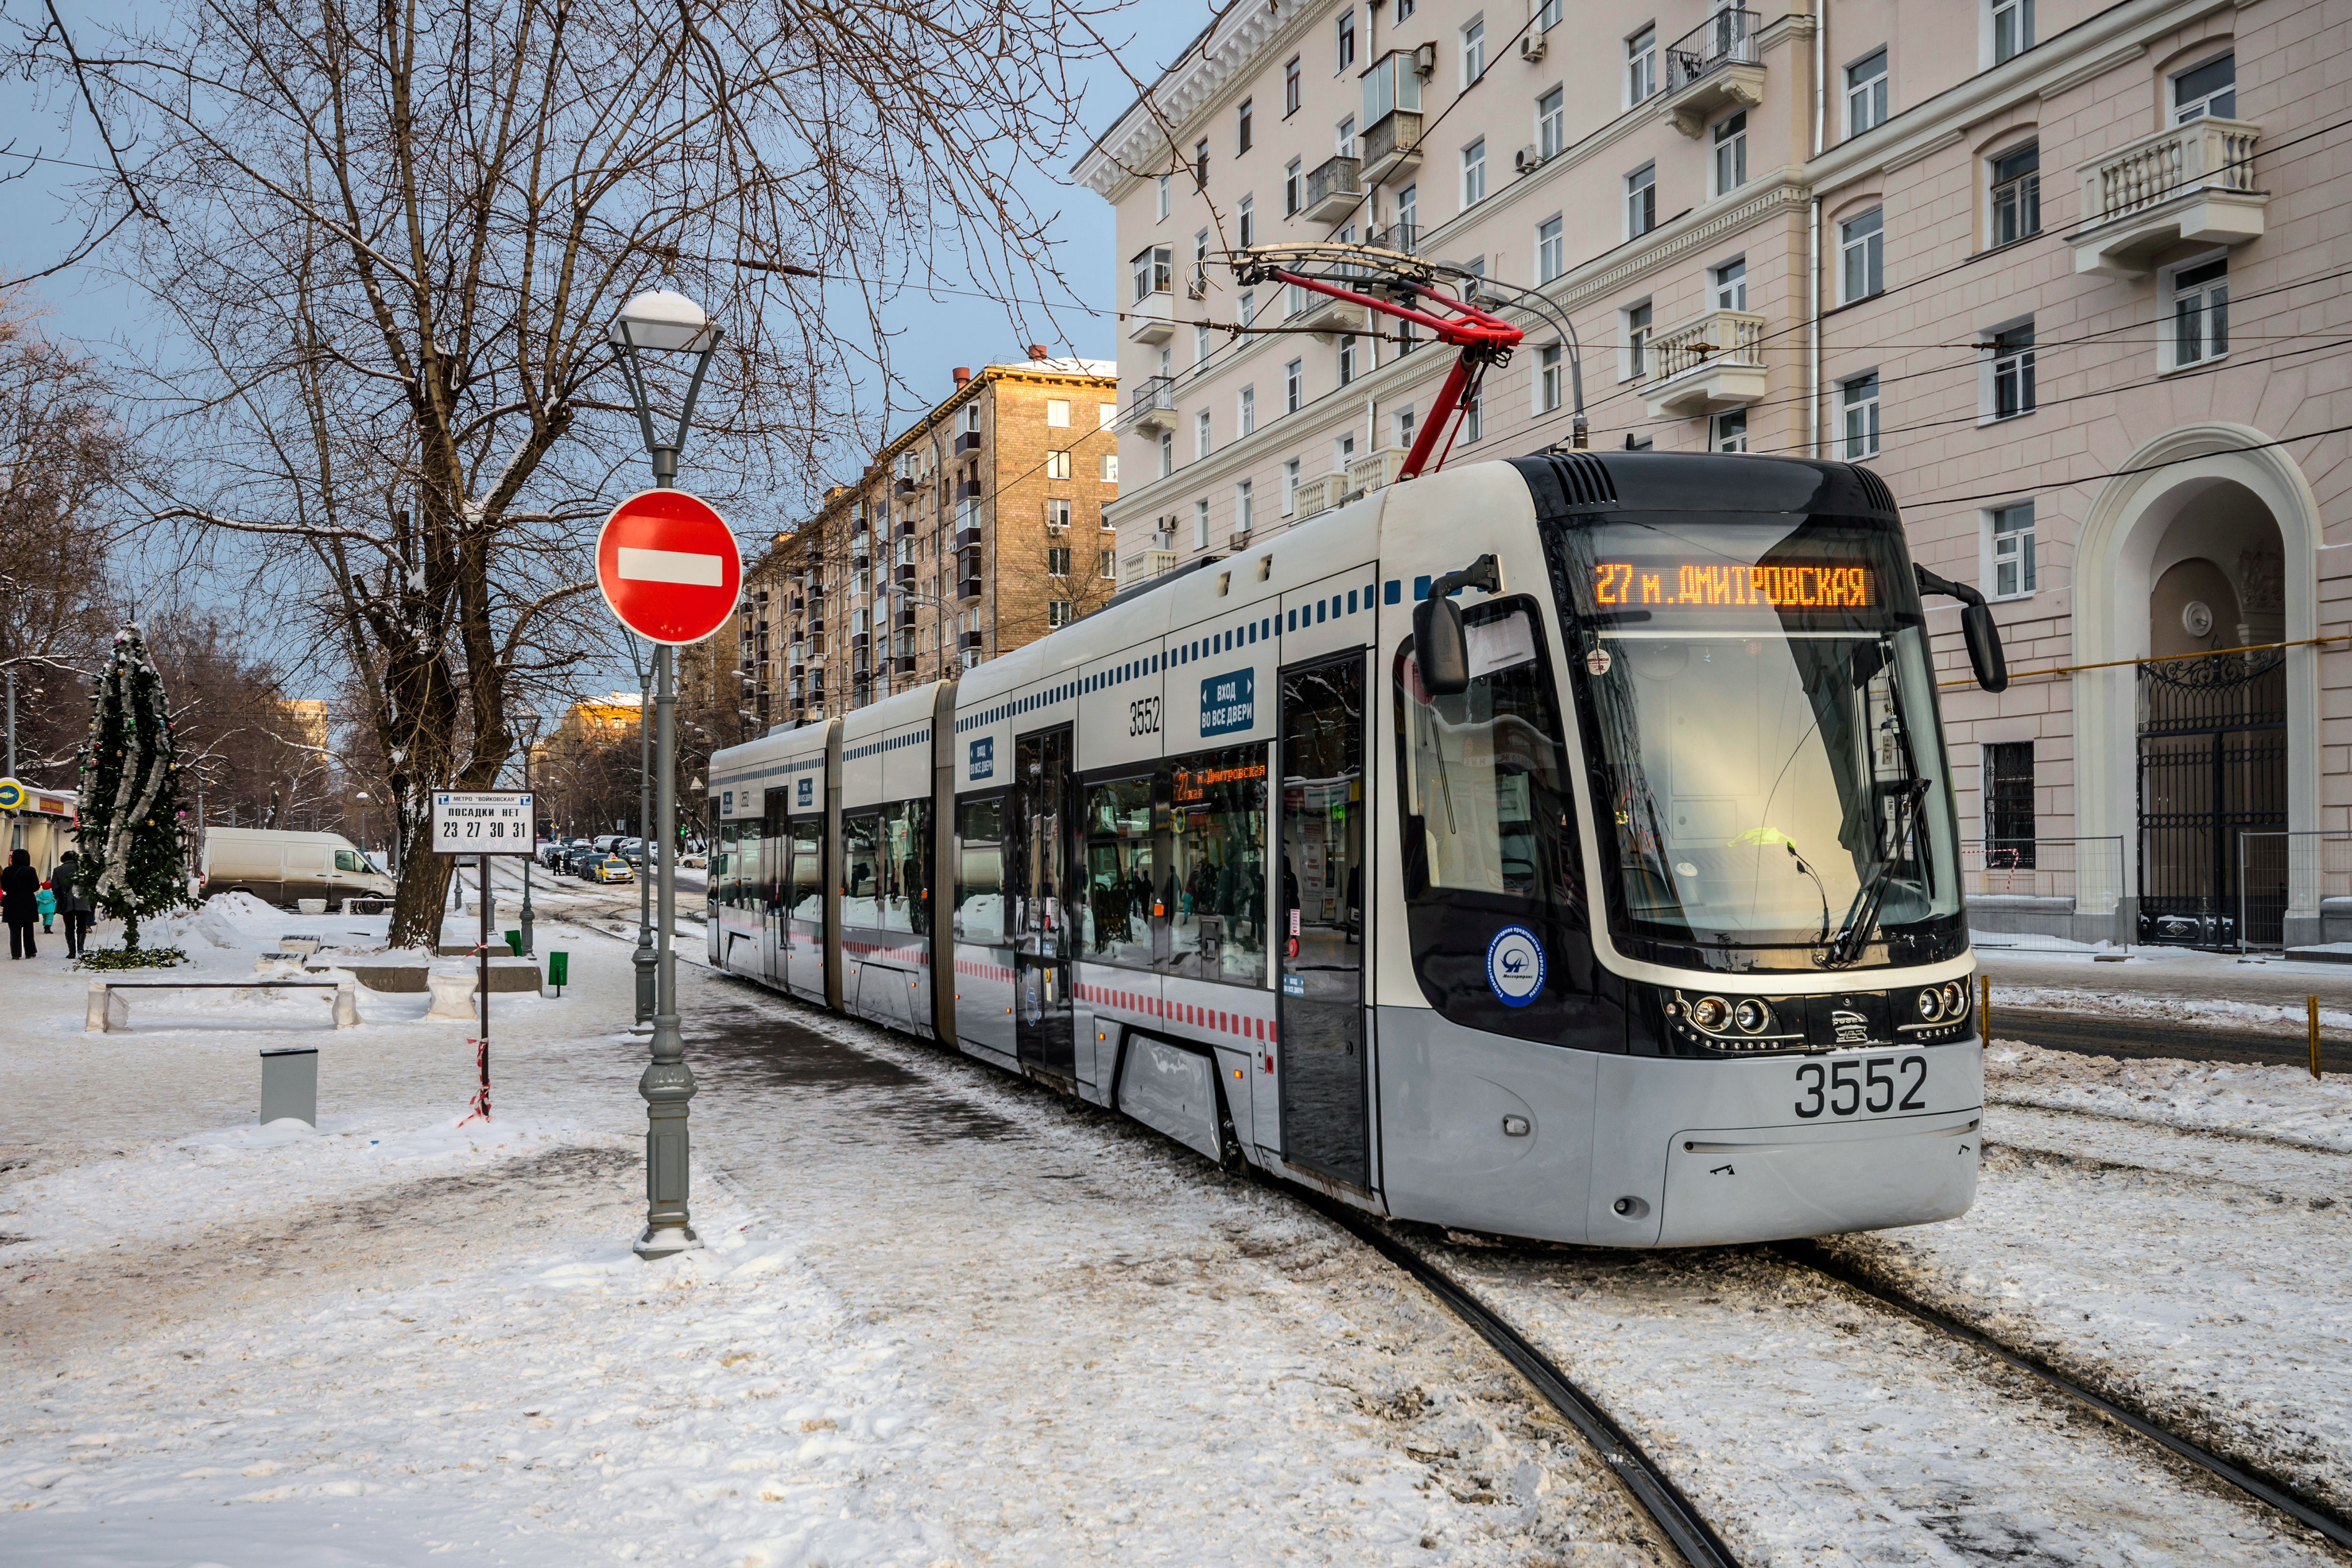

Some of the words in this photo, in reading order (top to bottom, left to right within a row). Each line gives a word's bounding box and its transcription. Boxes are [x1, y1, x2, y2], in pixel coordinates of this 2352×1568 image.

[1596, 564, 1632, 603] 27
[1217, 682, 1236, 701] ВХОД
[1130, 696, 1160, 737] 3552
[1202, 711, 1211, 728] ВО
[1212, 708, 1225, 726] ВСЕ
[1227, 702, 1252, 727] ДВЕРИ
[448, 808, 494, 818] ПОСАДКИ
[444, 822, 458, 837] 23
[467, 822, 481, 837] 27
[490, 822, 504, 837] 30
[513, 822, 525, 837] 31
[1529, 976, 1543, 998] Москвы
[1795, 1055, 1927, 1119] 3552
